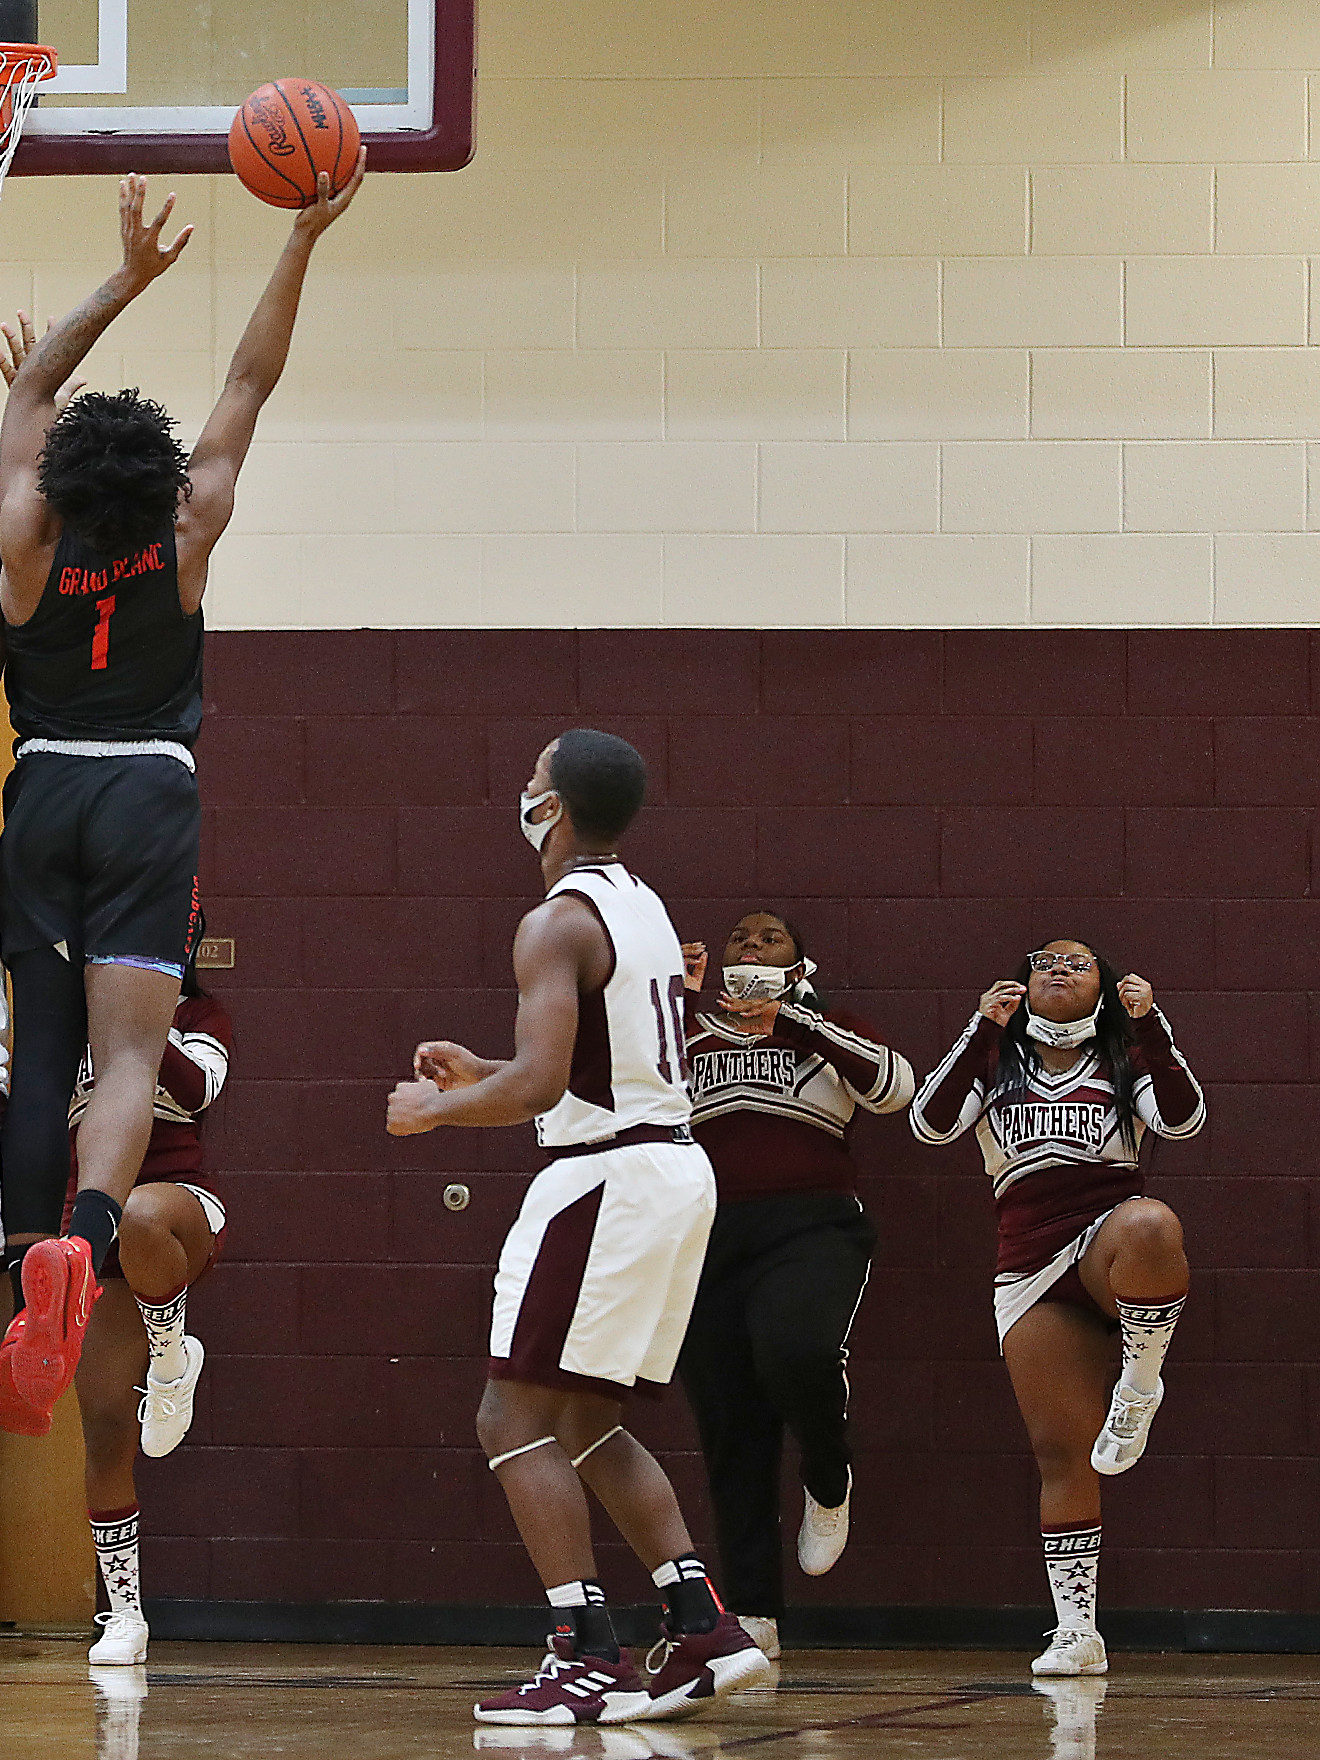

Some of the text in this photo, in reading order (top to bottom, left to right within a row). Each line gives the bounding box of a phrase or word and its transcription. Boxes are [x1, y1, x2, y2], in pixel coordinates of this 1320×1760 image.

[91, 594, 116, 670] 1
[693, 1051, 796, 1095] PANTHERS
[1002, 1104, 1105, 1149] PANTHERS
